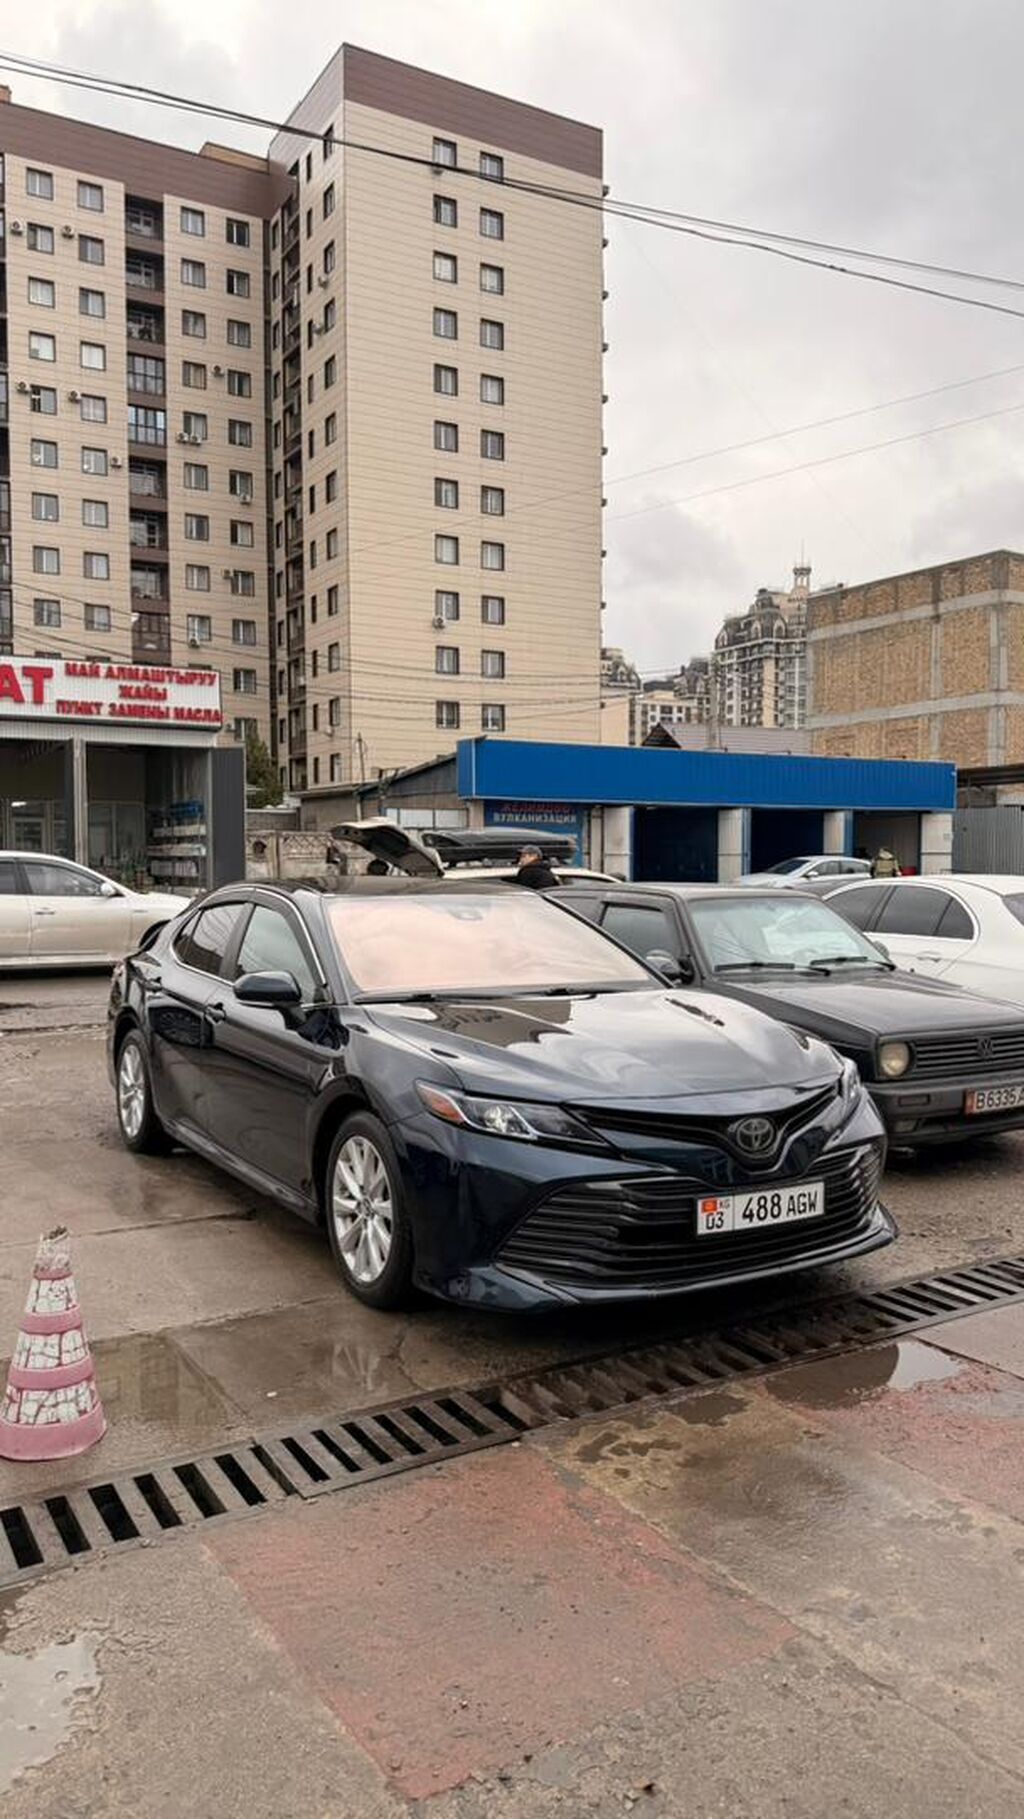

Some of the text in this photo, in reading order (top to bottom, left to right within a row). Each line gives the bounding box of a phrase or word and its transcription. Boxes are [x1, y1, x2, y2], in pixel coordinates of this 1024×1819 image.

[65, 661, 217, 686] МАЙ АЛМАШТЫРУУ
[118, 684, 167, 700] ЖАЙЫ
[56, 699, 223, 723] ПУНКТ ЗАМЕНЫ МАСЛА
[493, 812, 577, 824] ВУЛКАНИЗАЦИЯ
[706, 1190, 818, 1230] 03 488 AGW
